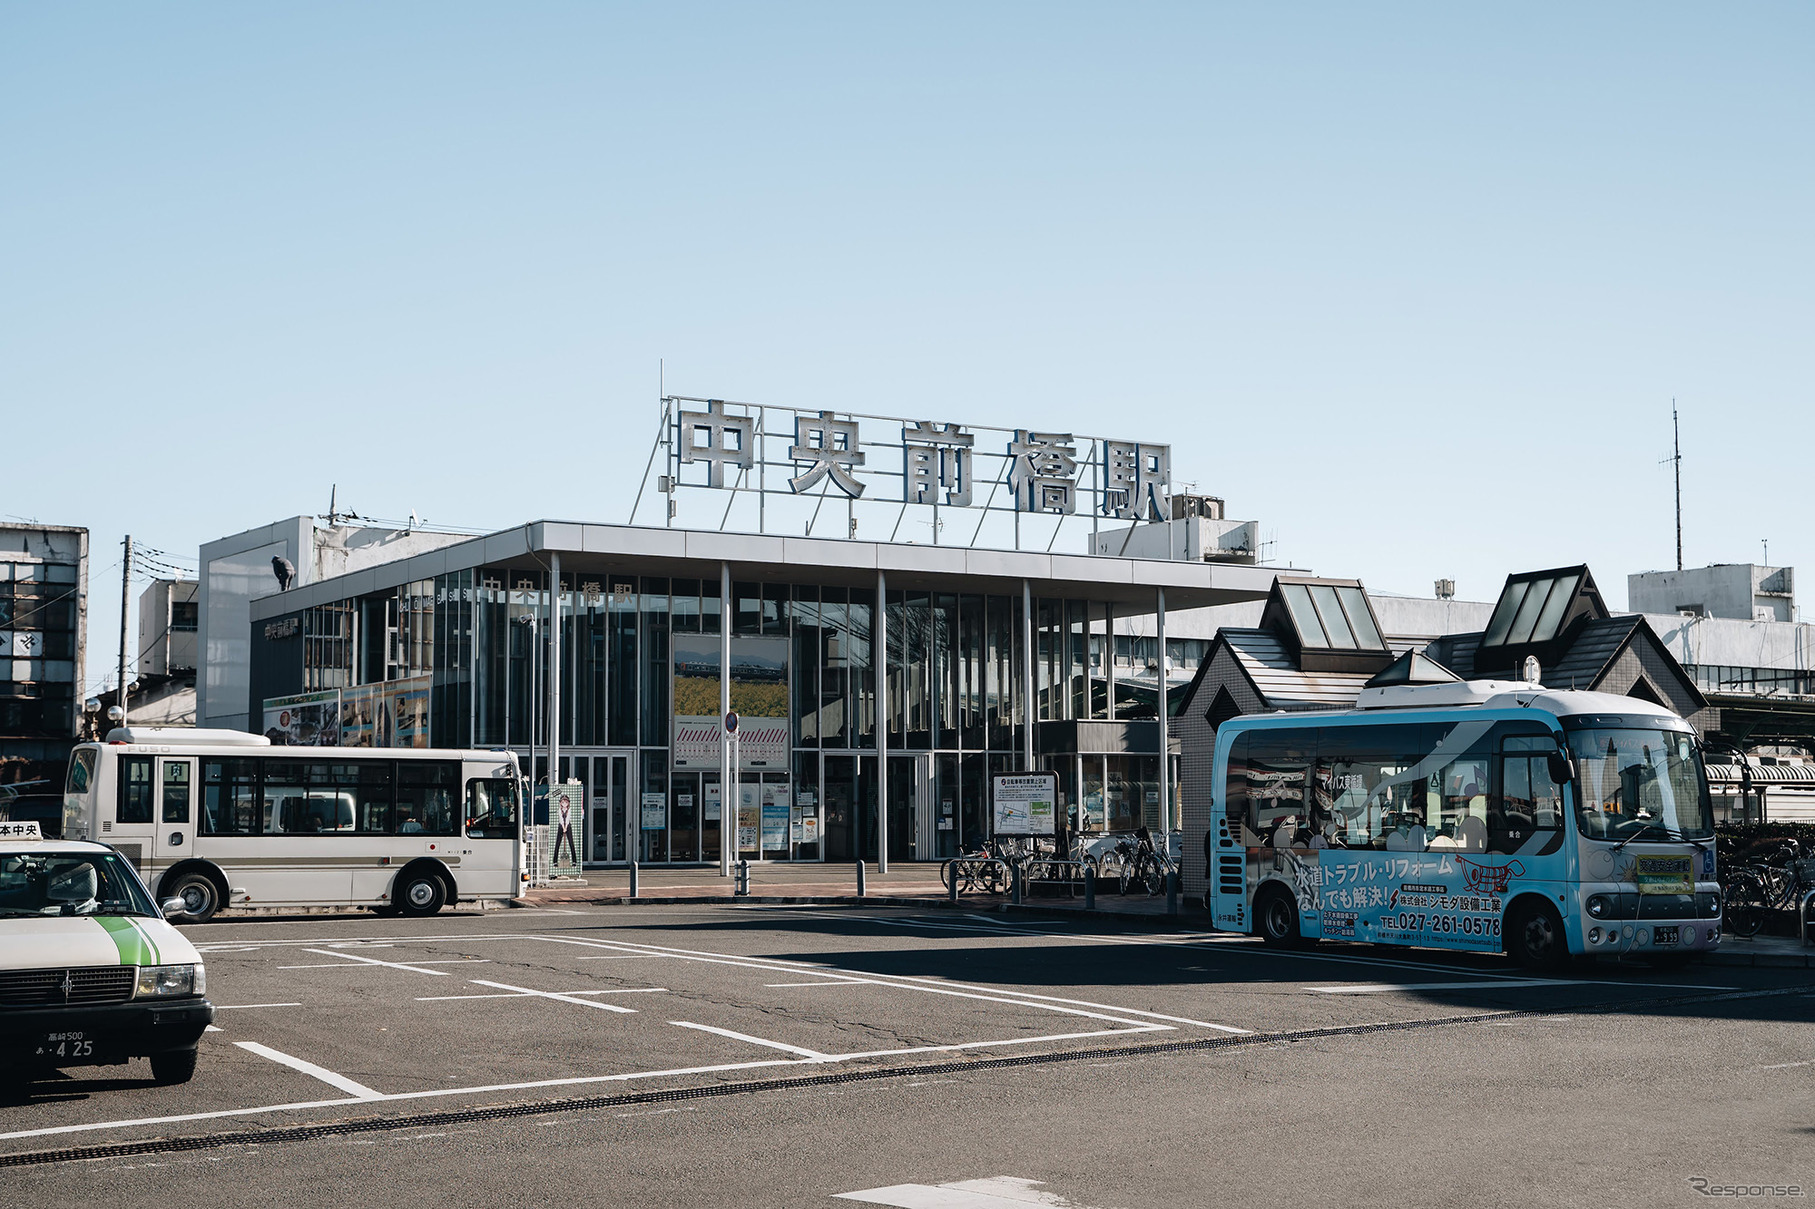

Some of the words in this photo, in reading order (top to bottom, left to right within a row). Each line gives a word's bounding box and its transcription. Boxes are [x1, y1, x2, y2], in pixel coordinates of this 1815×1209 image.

[678, 399, 1171, 521] 中央前橋駅
[1295, 854, 1453, 888] 水道トラブル・リフォーム
[1400, 896, 1428, 907] 株式会社
[1430, 895, 1502, 913] シモダ設備工業
